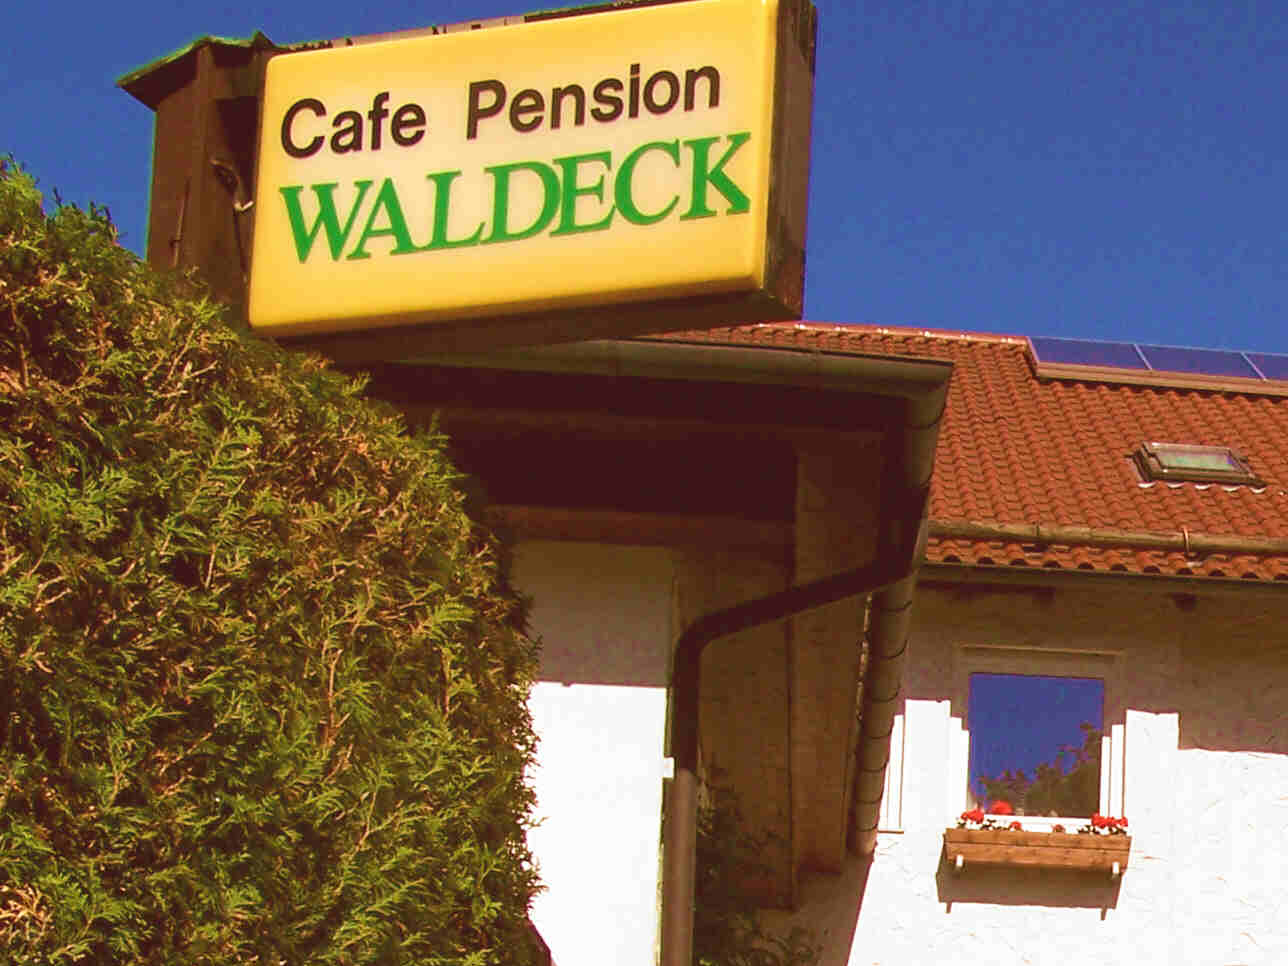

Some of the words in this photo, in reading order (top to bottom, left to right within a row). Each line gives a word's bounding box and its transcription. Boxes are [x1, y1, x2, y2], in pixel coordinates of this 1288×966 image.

[281, 91, 426, 159] Cafe
[466, 63, 721, 140] Pension
[279, 131, 752, 263] WALDECK
